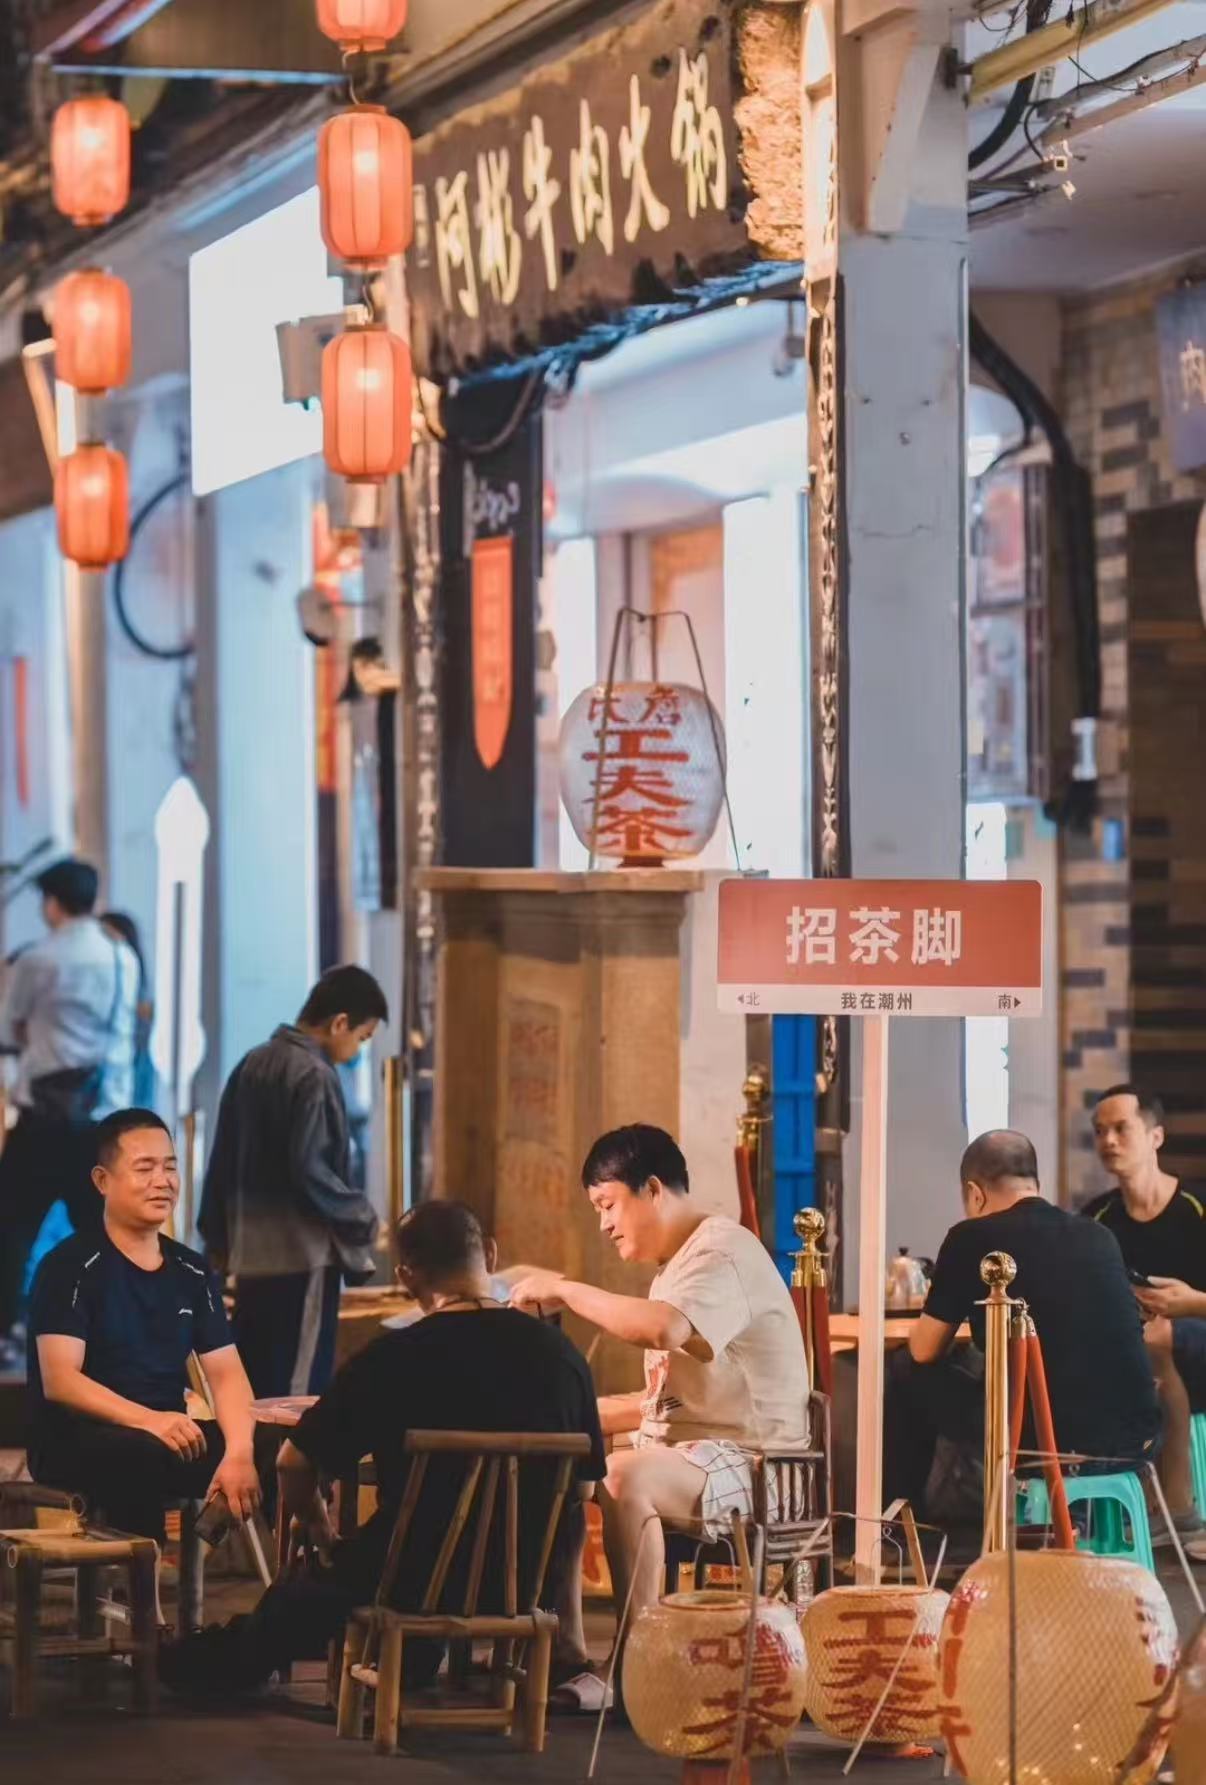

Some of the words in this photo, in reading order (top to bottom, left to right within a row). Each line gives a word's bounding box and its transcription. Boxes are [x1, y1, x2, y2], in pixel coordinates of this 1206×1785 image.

[582, 729, 694, 852] 工夫茶
[785, 906, 962, 966] 招茶脚
[746, 992, 761, 1006] 北
[840, 991, 913, 1011] 我在潮州
[997, 994, 1013, 1010] 南
[821, 1609, 938, 1737] 工夫茶
